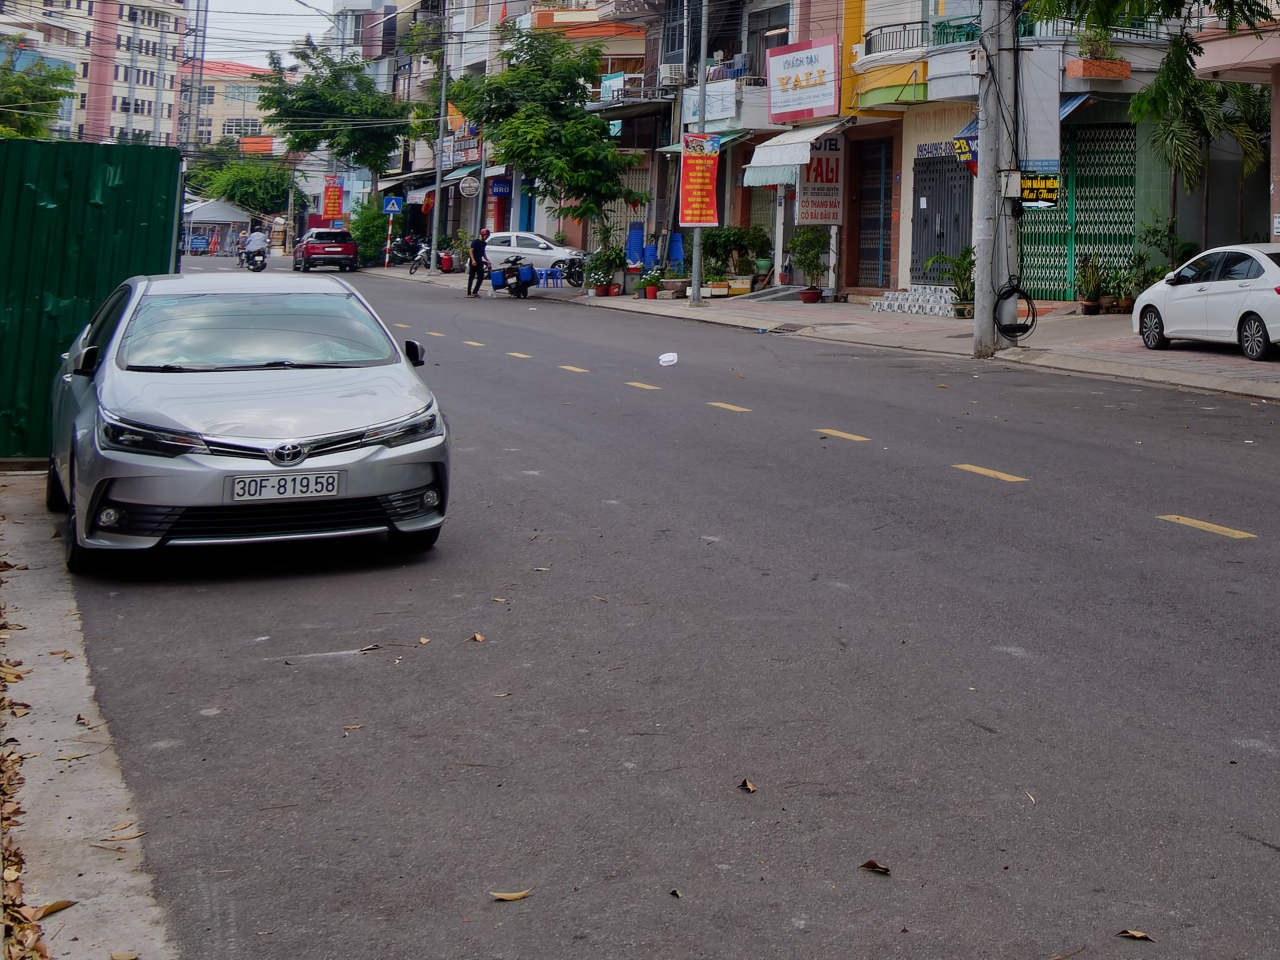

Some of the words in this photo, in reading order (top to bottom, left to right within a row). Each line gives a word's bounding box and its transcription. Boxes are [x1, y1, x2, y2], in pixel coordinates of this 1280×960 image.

[776, 69, 826, 93] YALI
[806, 157, 840, 183] YALI
[235, 475, 336, 498] 30F-819.58
